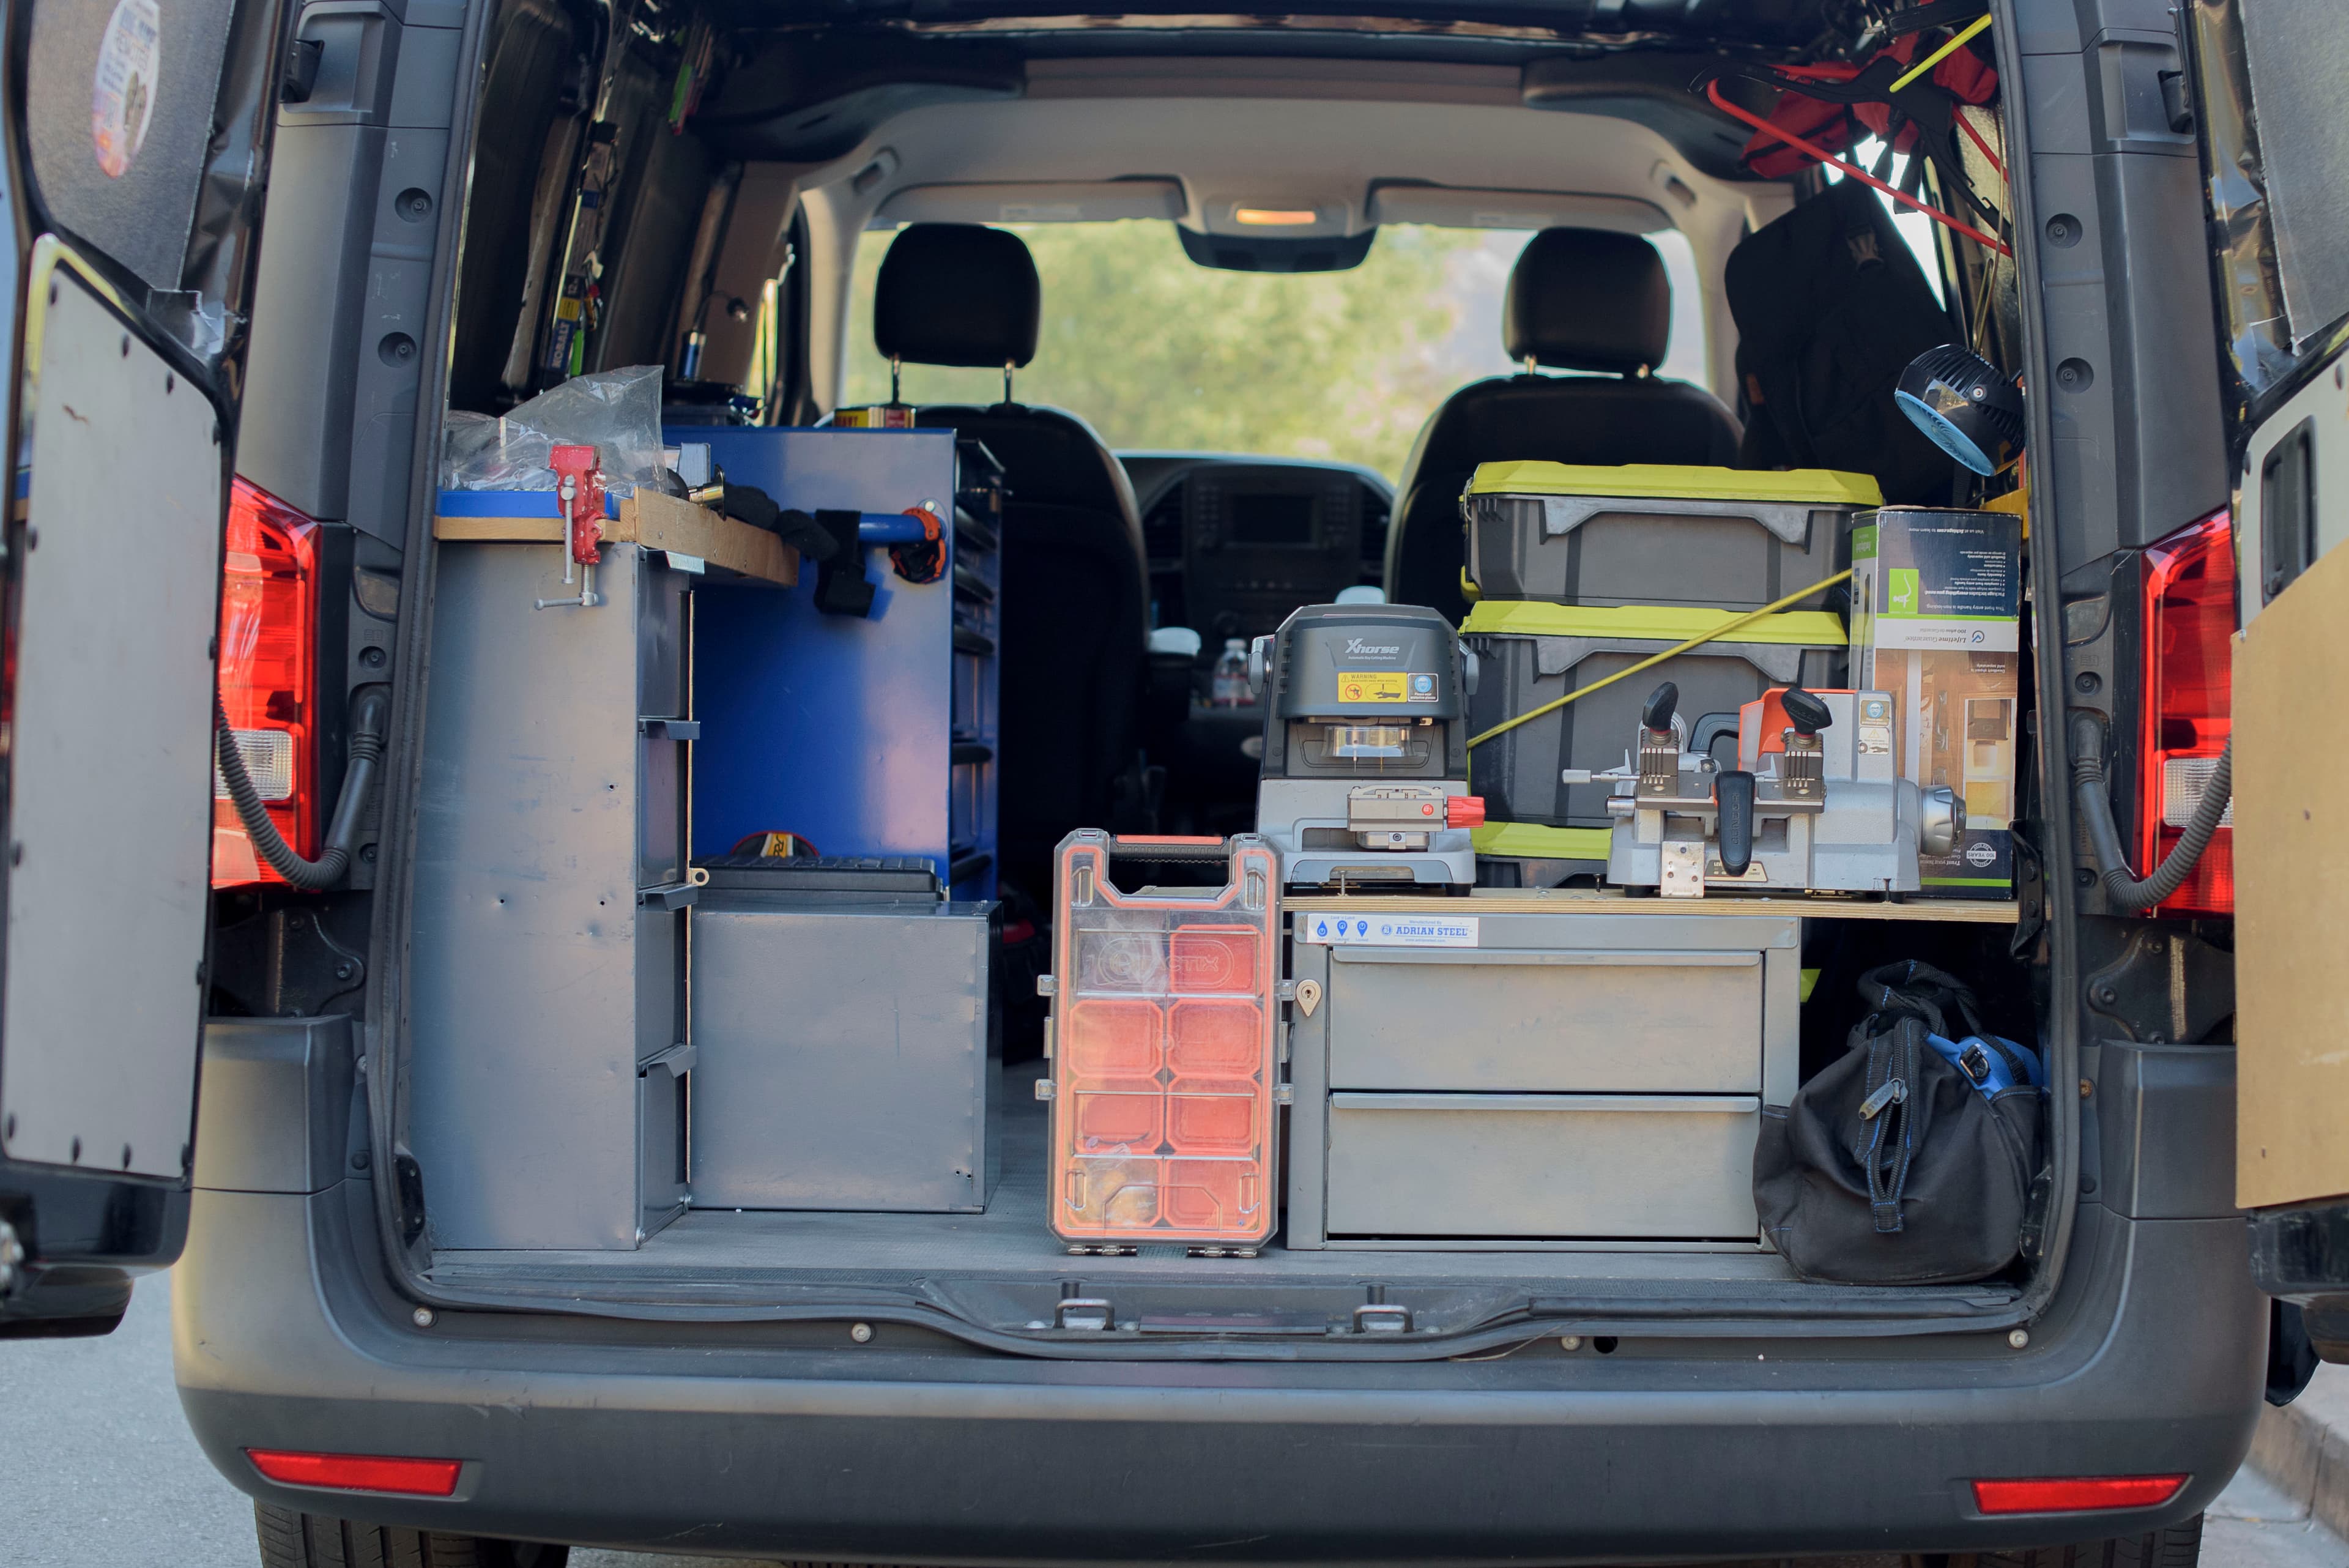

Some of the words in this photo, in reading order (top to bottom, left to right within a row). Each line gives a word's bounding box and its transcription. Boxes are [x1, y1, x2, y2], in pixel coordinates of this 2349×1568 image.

[551, 321, 570, 369] KOBALT
[1344, 638, 1400, 654] Xhorse
[1396, 926, 1434, 935] ADRIAN
[1437, 927, 1468, 936] STEEL
[1141, 956, 1219, 972] TACTIX
